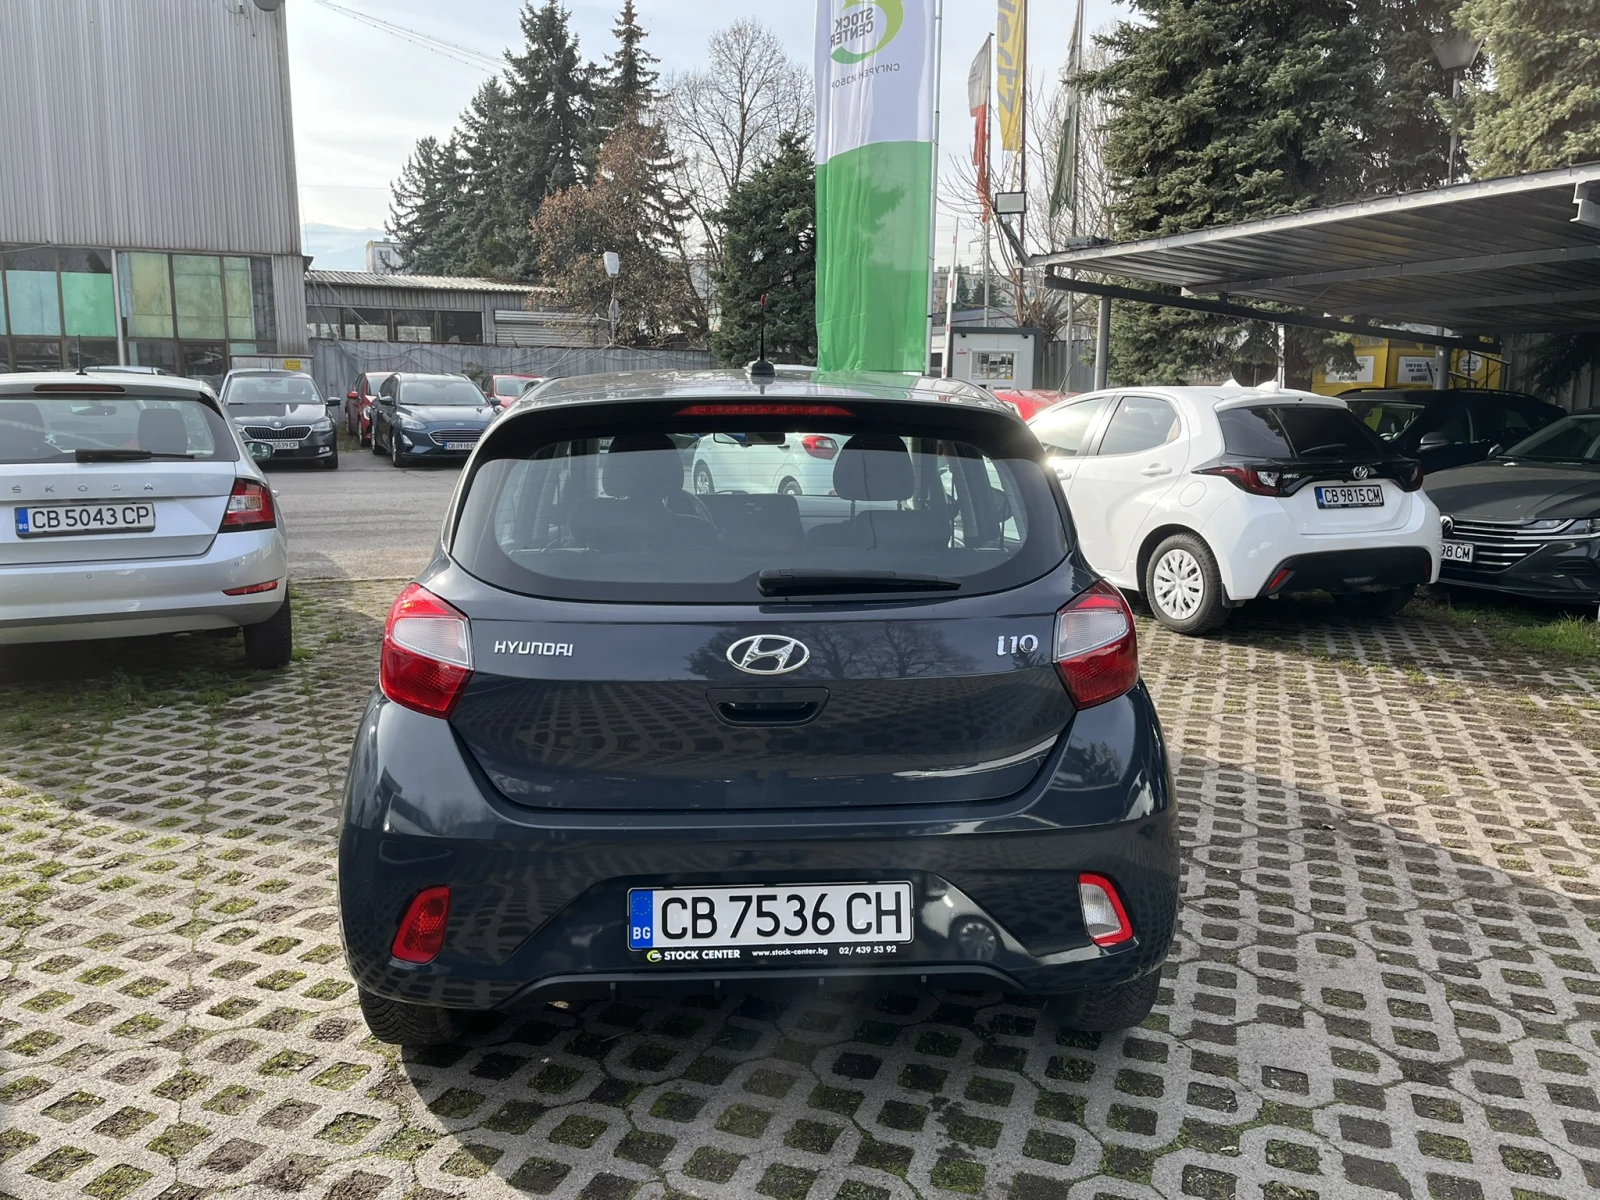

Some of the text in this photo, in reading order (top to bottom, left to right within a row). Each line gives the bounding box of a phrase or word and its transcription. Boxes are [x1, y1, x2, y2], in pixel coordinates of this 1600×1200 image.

[1324, 487, 1381, 503] CB 9815 CM
[32, 510, 61, 529] CB
[65, 507, 118, 527] 5043
[122, 506, 149, 524] CP
[1455, 546, 1470, 560] CM
[494, 640, 574, 657] HYUNDAI
[632, 891, 901, 940] BG CB 7536 CH
[664, 949, 741, 961] STOCK CENTER
[752, 947, 828, 957] www.stock-center.bg
[839, 945, 897, 956] 02/ 439 53 92
